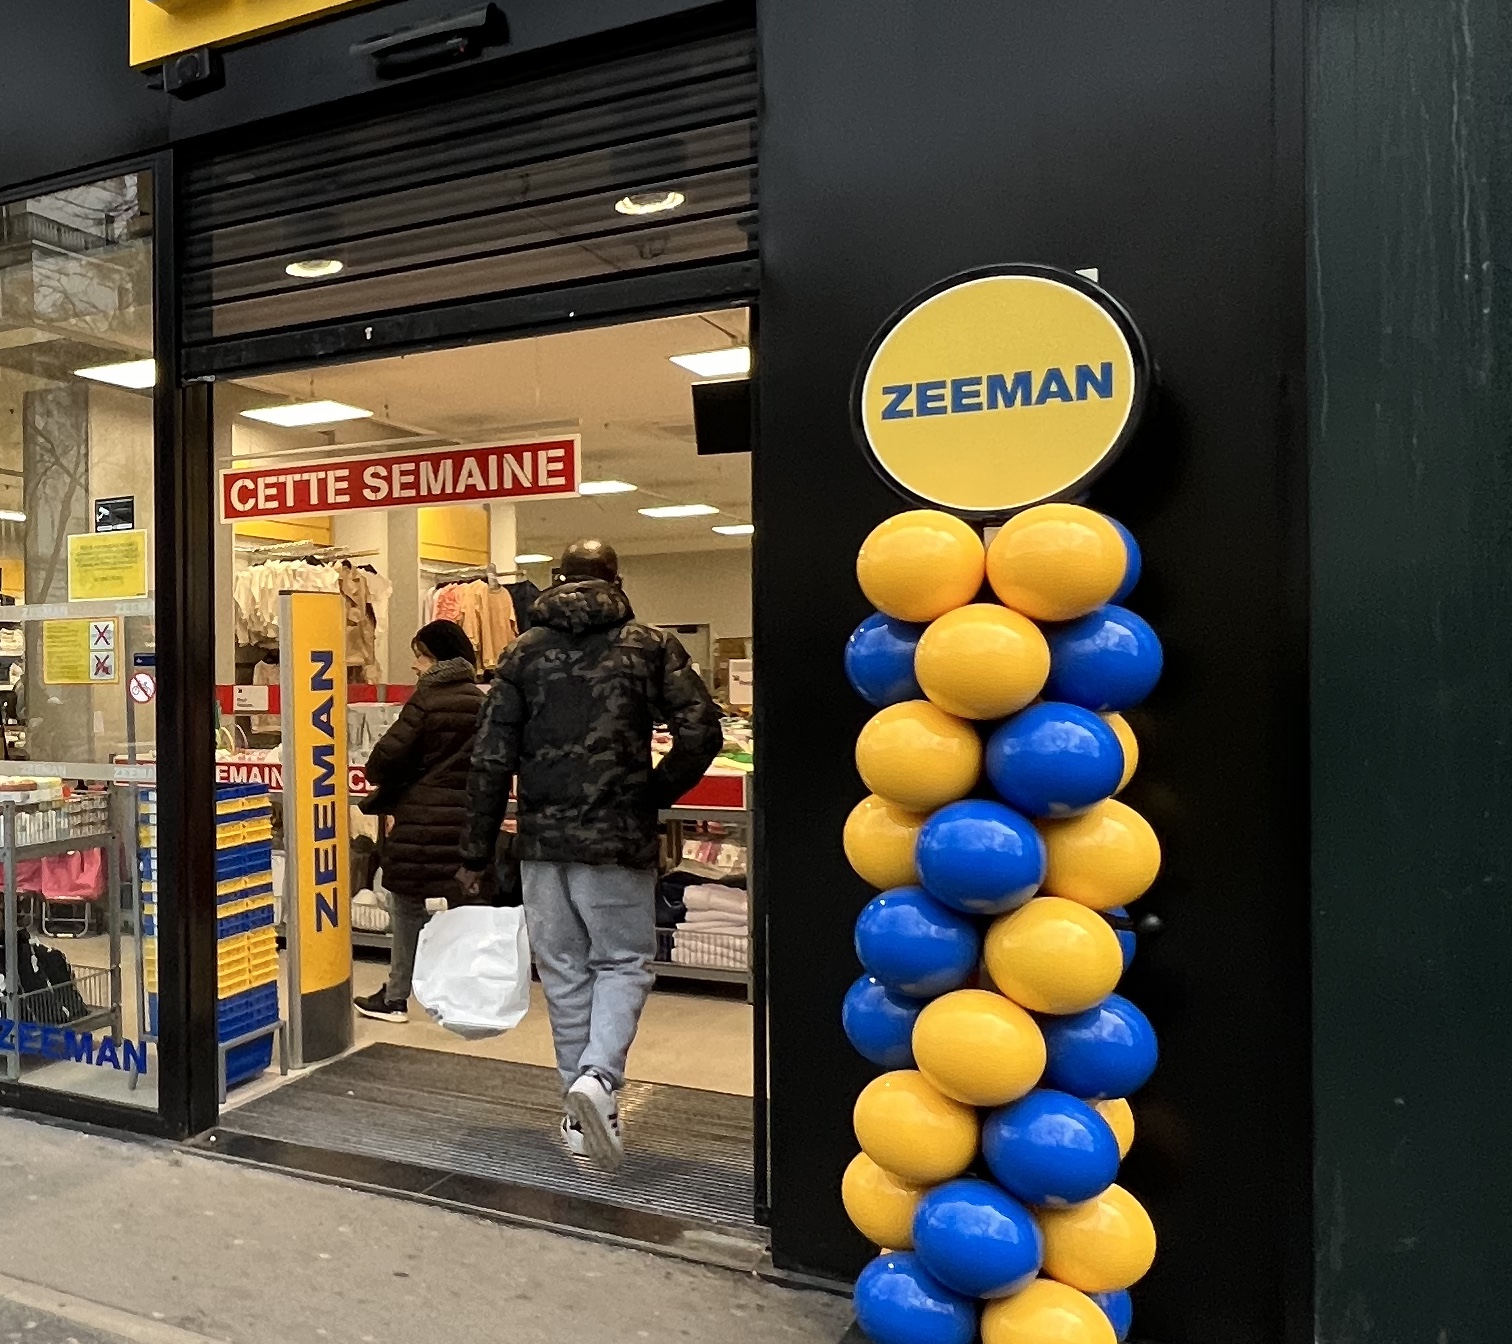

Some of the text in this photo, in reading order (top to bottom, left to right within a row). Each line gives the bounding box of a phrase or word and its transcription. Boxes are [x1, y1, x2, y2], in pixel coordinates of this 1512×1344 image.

[881, 360, 1114, 421] ZEEMAN
[229, 448, 567, 513] CETTE SEMAINE
[114, 766, 156, 780] ZEEMA
[215, 765, 284, 789] EMAIN
[310, 649, 339, 933] ZEEMAN
